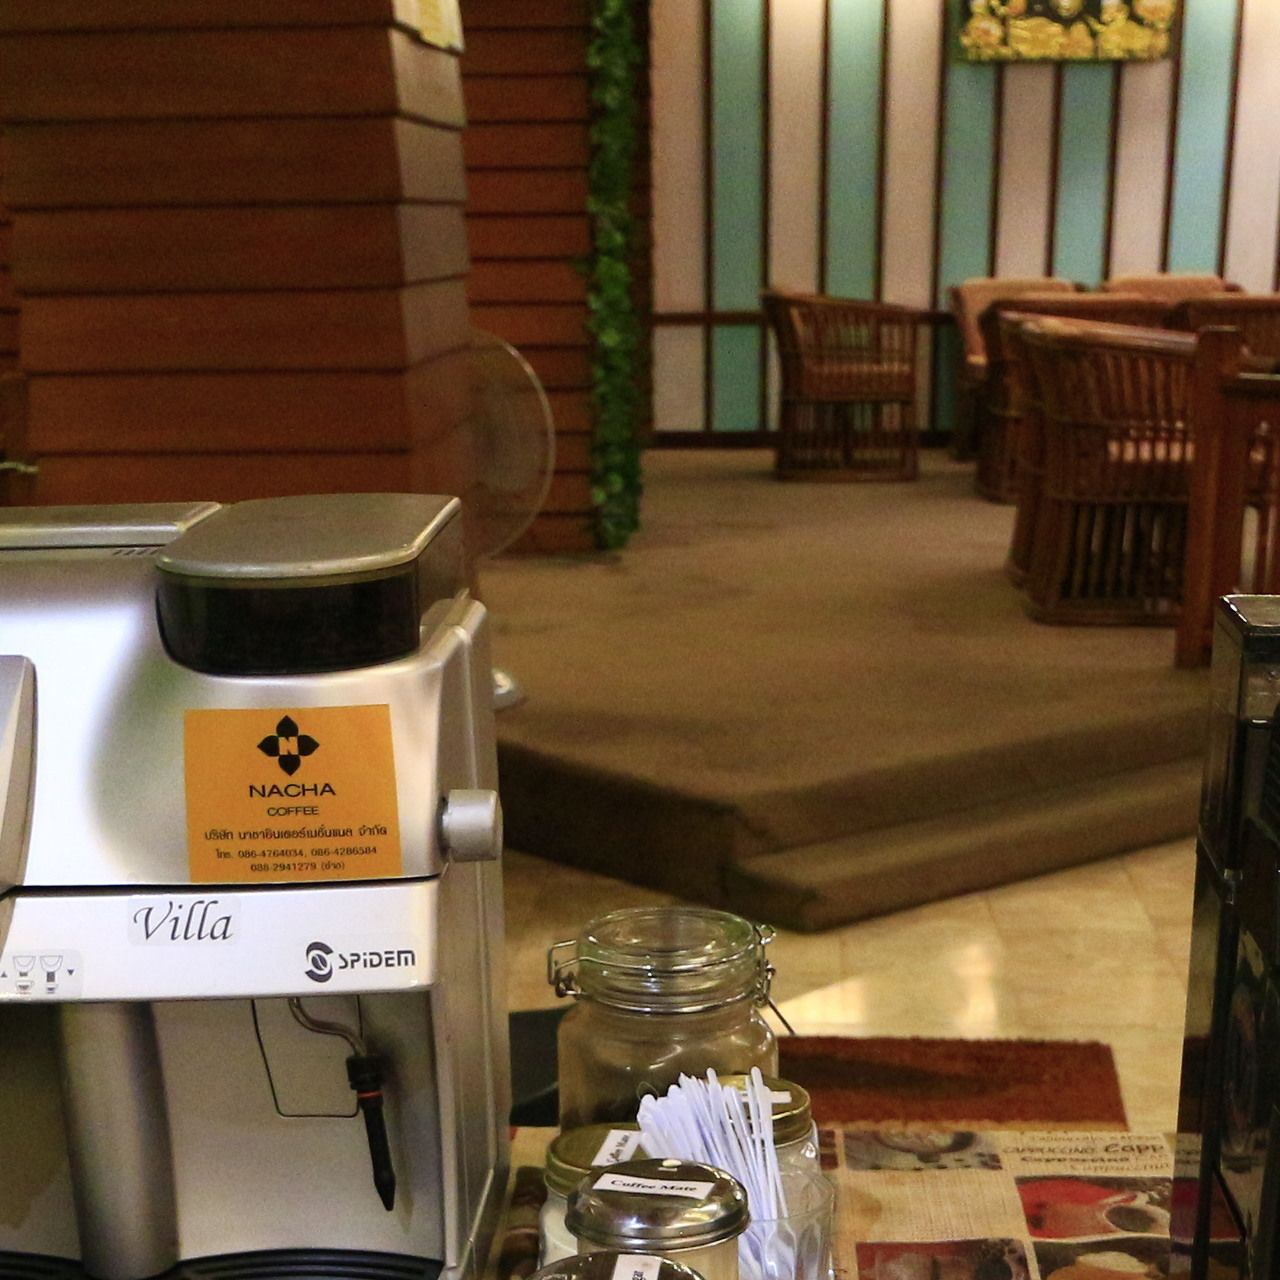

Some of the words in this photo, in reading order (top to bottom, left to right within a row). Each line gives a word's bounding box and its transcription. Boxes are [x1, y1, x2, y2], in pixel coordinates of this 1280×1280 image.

[249, 783, 336, 798] NACHA
[267, 806, 319, 816] COFFEE
[133, 900, 234, 941] Villa
[611, 1179, 656, 1190] Coffee
